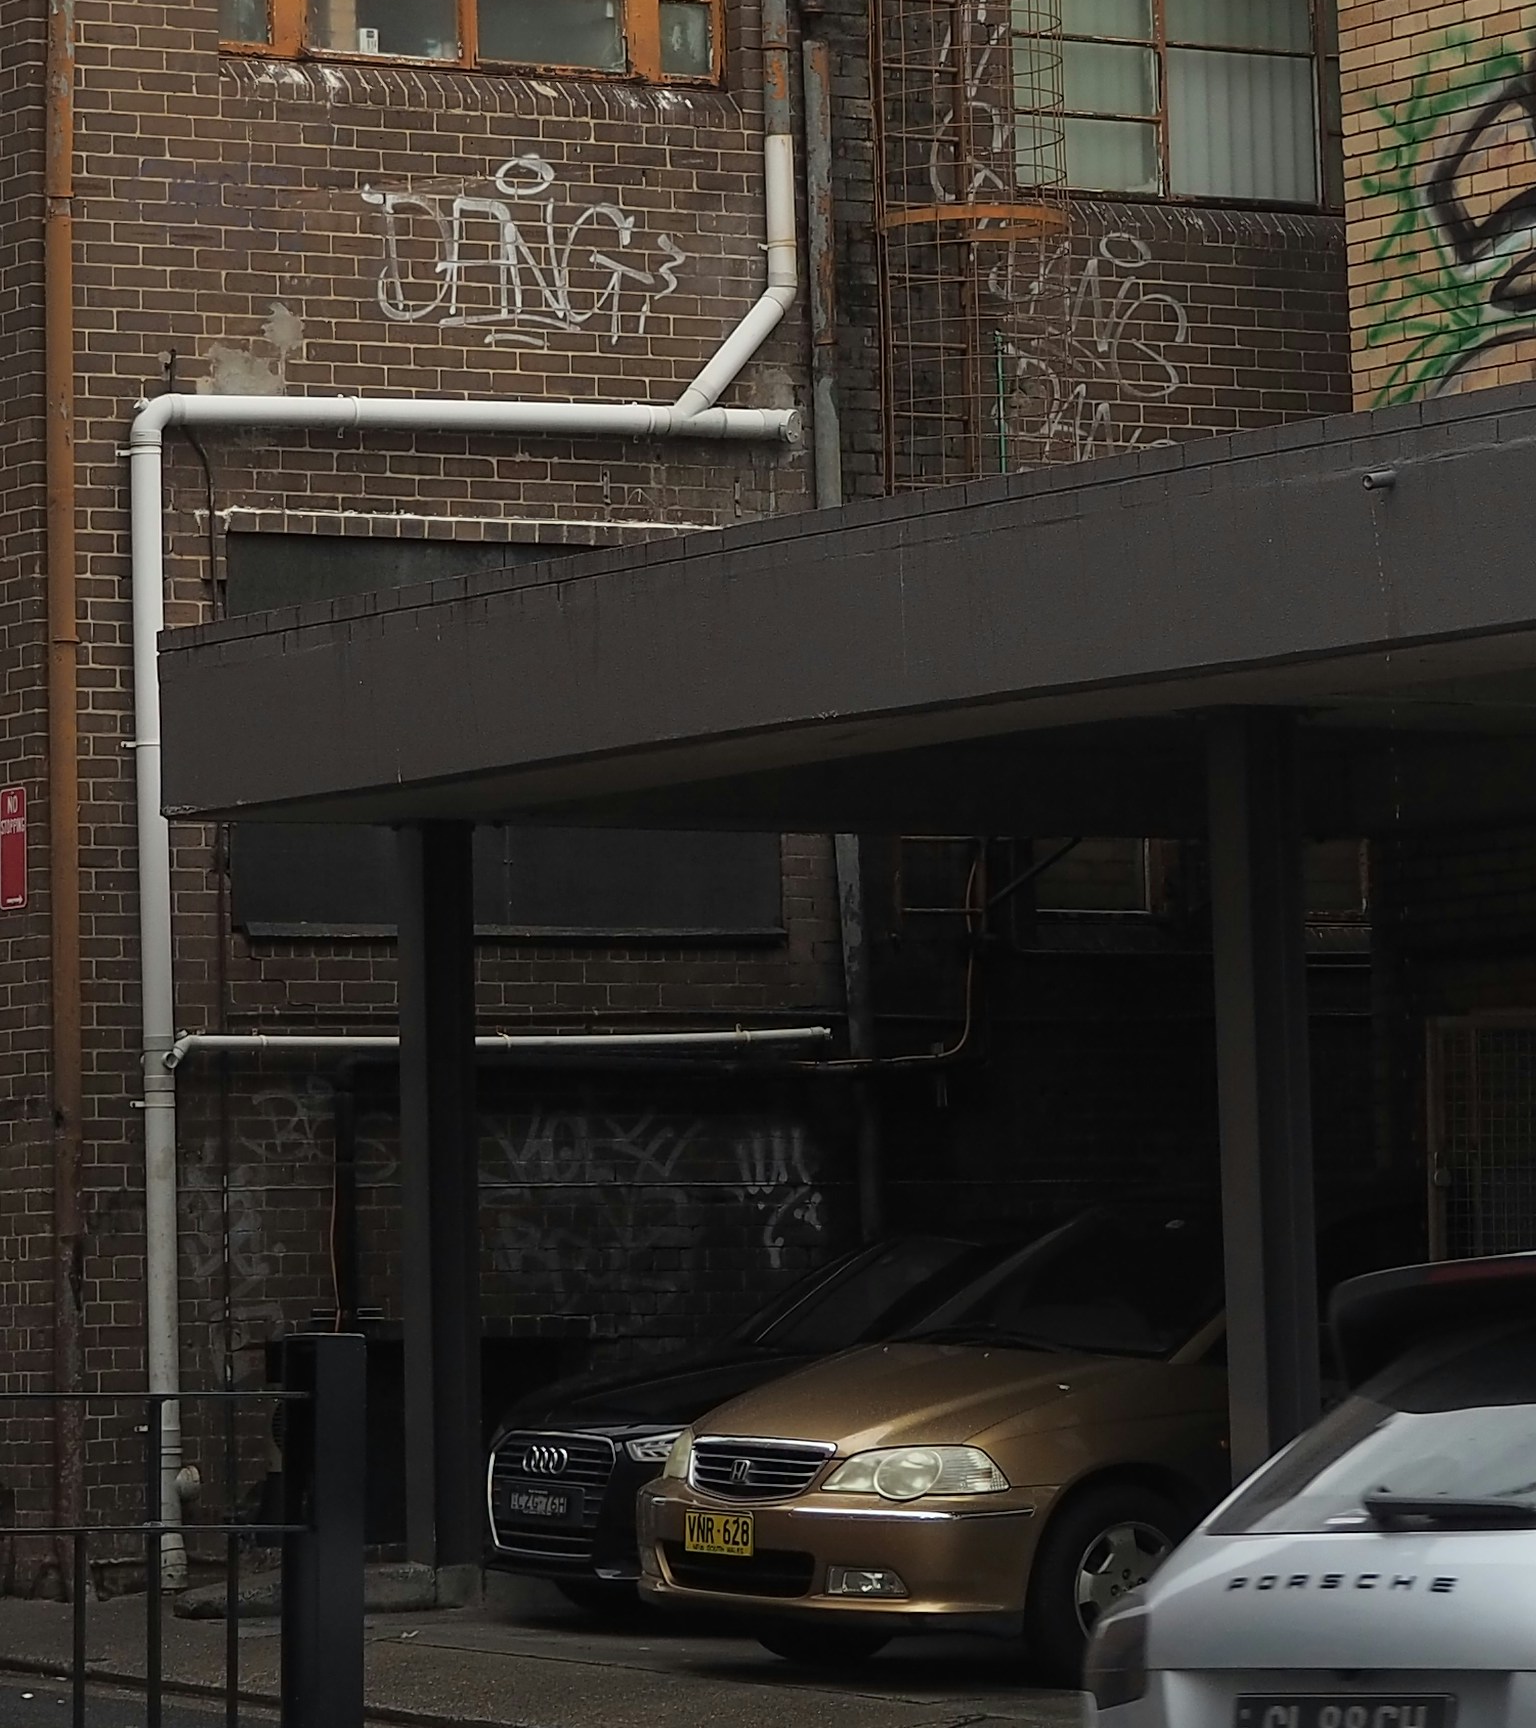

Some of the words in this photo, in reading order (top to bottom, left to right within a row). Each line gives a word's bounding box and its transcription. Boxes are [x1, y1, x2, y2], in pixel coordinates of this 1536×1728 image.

[7, 795, 18, 814] NO
[0, 817, 25, 835] STOPPING
[1226, 1573, 1459, 1593] PORSCHE
